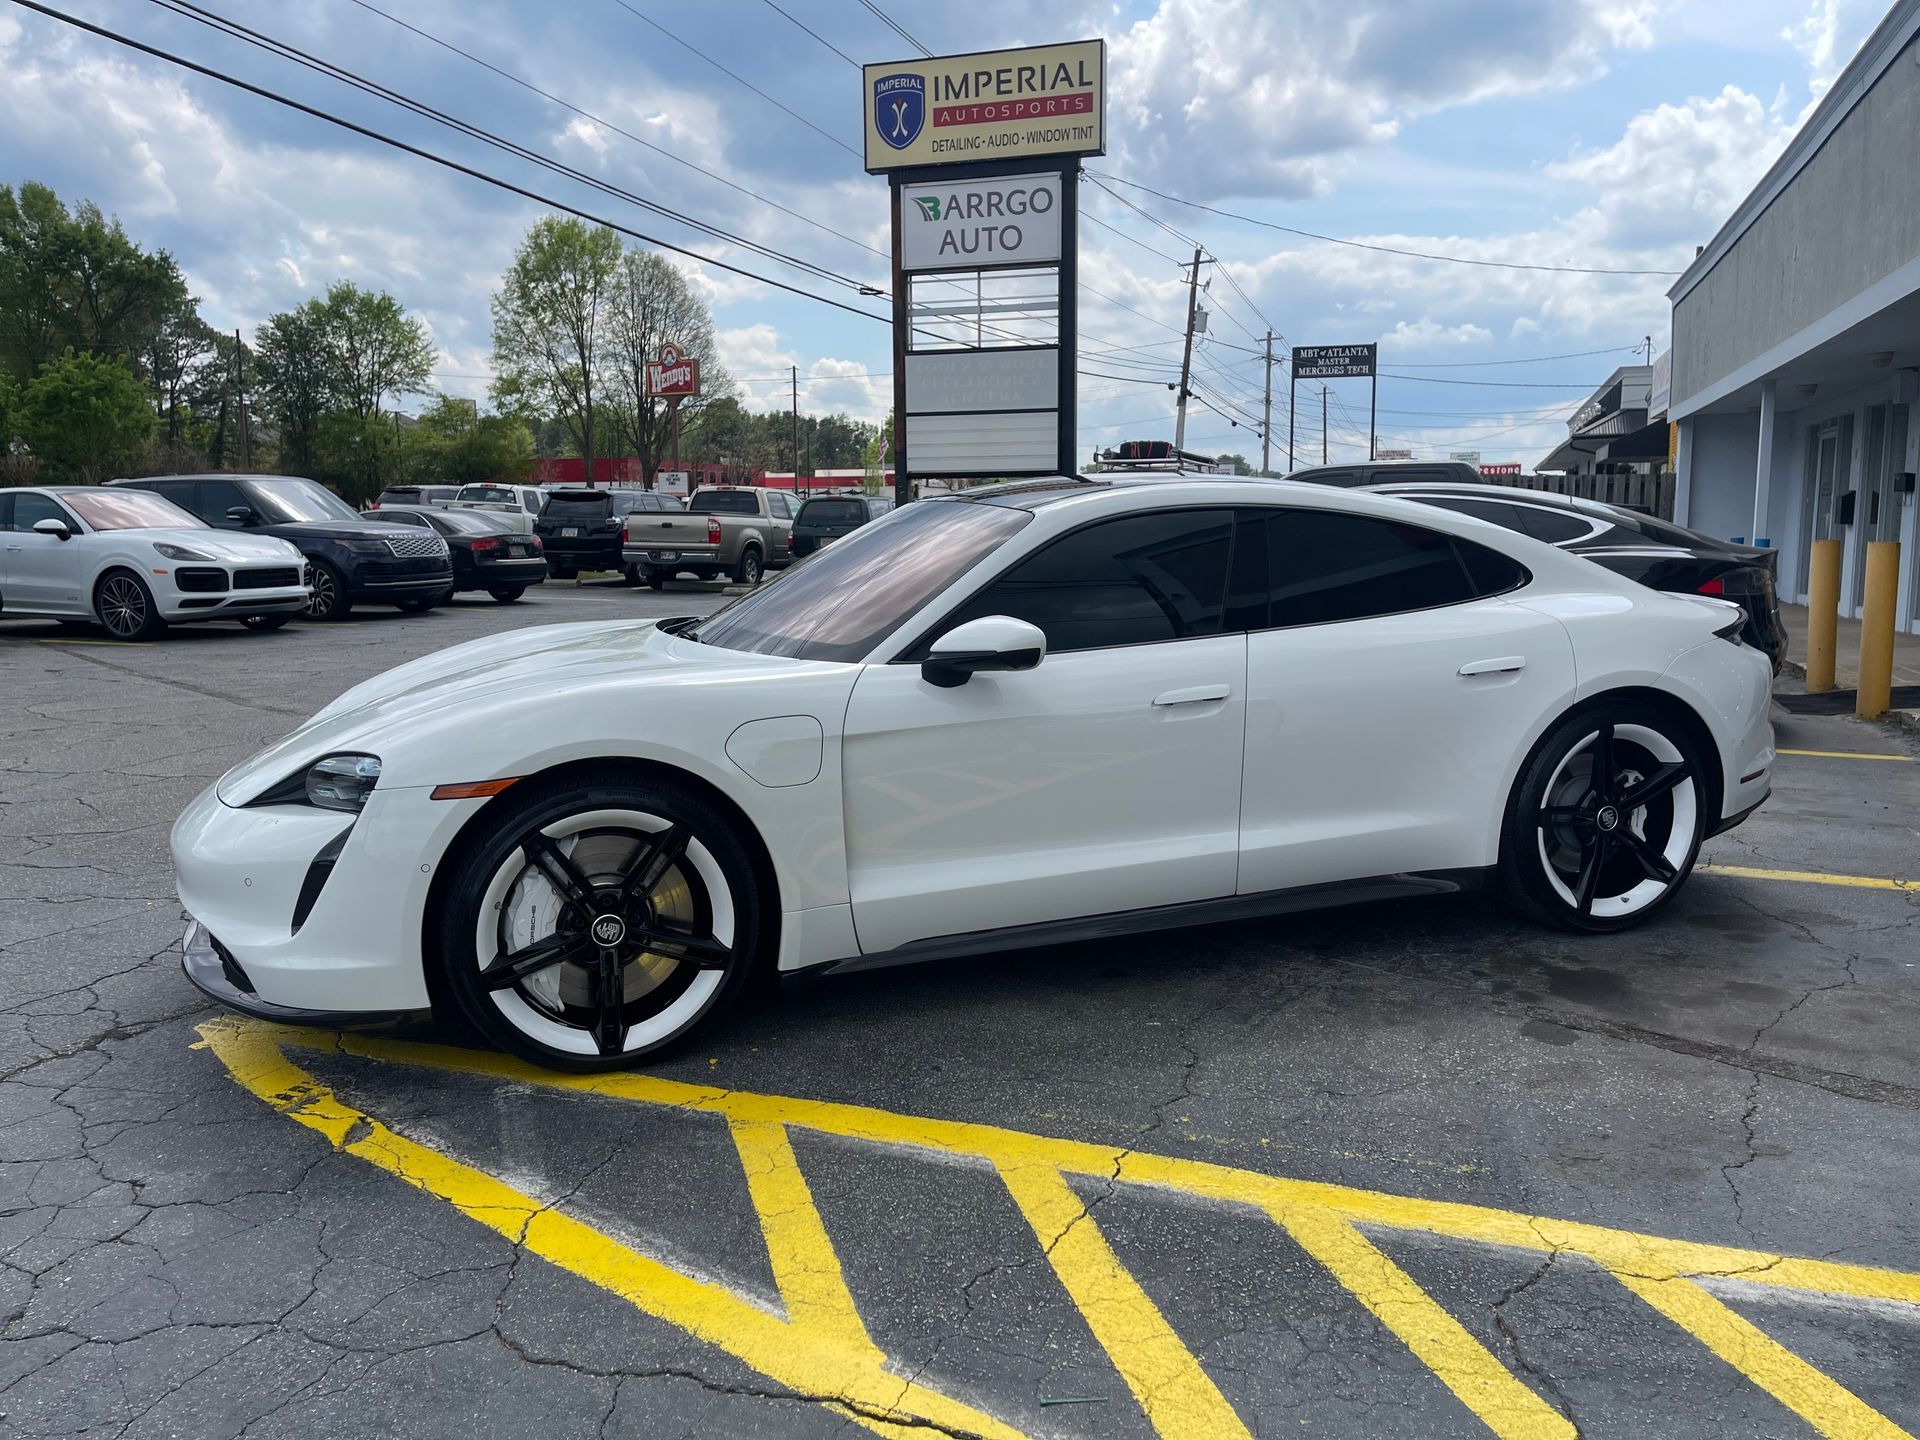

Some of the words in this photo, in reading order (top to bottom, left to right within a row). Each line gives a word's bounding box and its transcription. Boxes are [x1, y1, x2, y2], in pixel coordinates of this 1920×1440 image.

[877, 77, 923, 92] IMPERIAL
[934, 60, 1093, 102] IMPERIAL
[940, 97, 1085, 123] AUTOSPORTS
[932, 136, 980, 153] DETAILING
[987, 132, 1020, 149] AUDIO
[1026, 127, 1071, 145] WINDOW
[1072, 125, 1094, 141] TINT
[910, 187, 1053, 222] BARRGO
[938, 224, 1023, 255] AUTO
[1300, 348, 1319, 358] MBT
[1327, 347, 1369, 357] ATLANTA
[1317, 357, 1350, 366] MASTER
[1298, 366, 1344, 376] MERCEDES
[1347, 365, 1369, 374] TECH
[1479, 465, 1520, 474] restone
